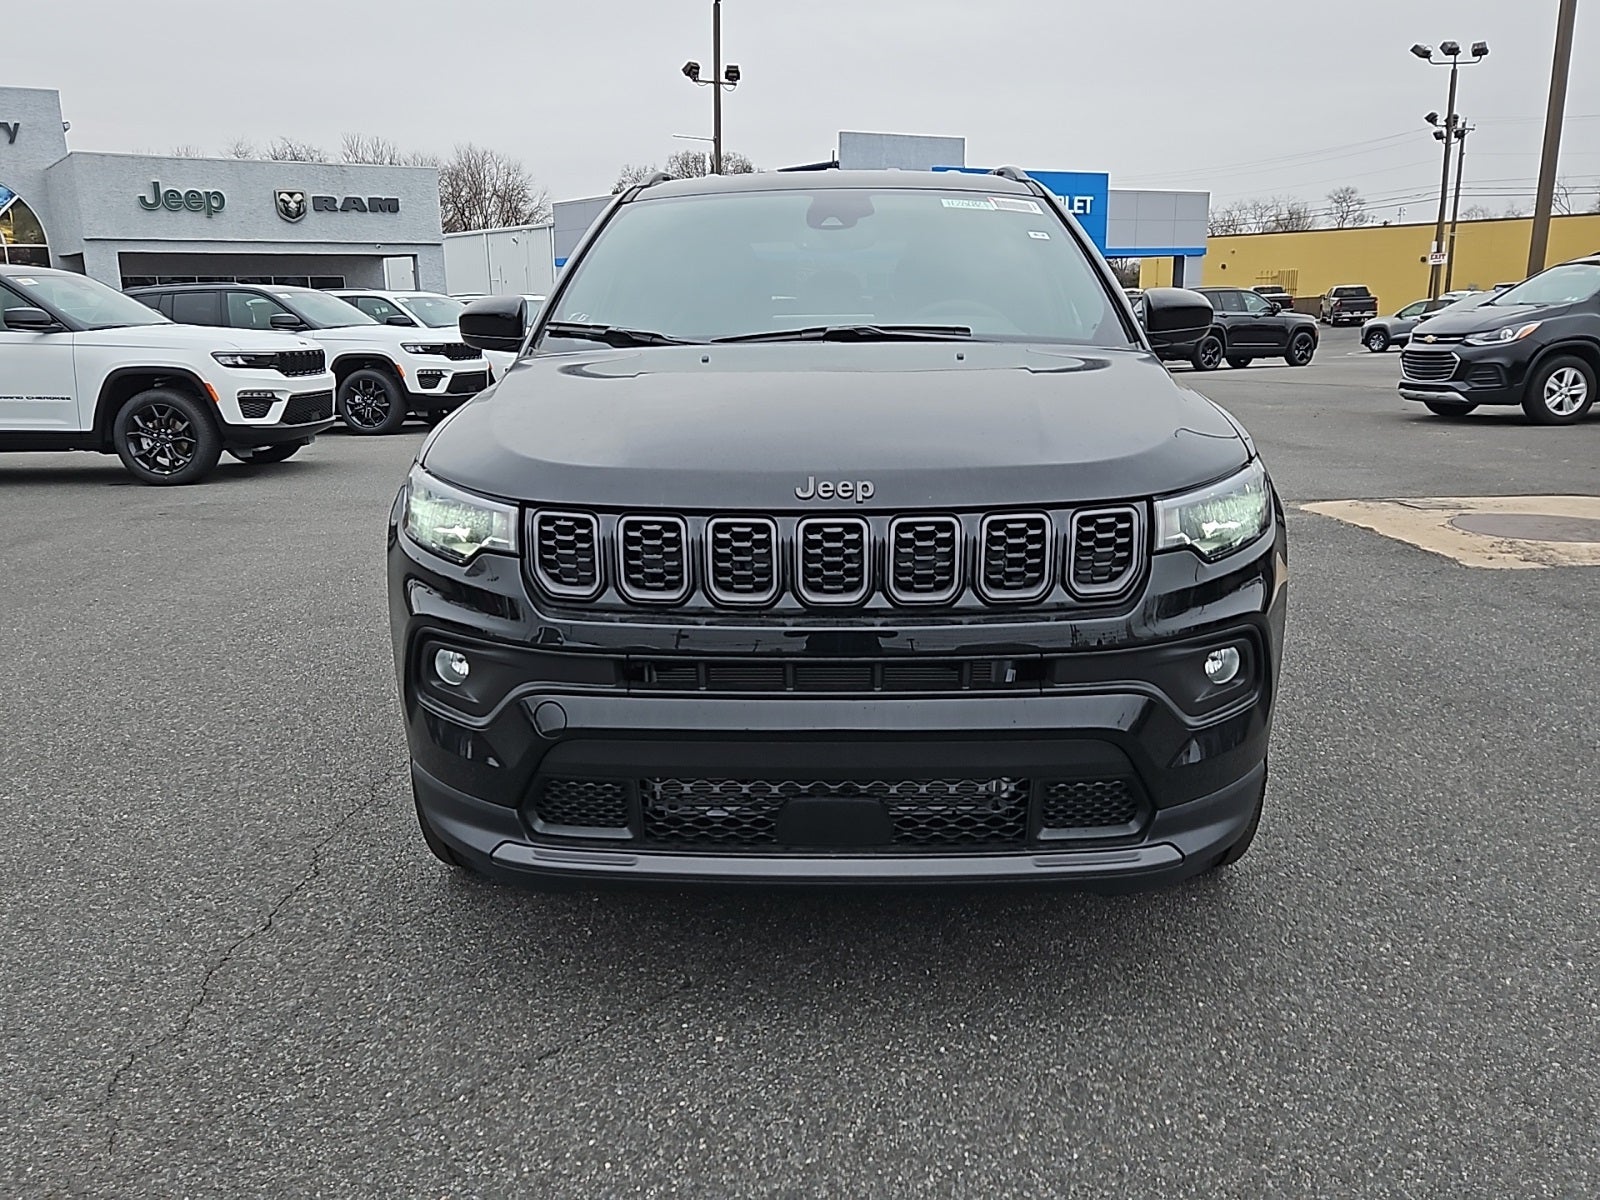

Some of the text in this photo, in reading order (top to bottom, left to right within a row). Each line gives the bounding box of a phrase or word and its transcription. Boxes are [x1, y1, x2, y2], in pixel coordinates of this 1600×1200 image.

[0, 121, 20, 144] y
[138, 180, 226, 218] Jeep
[311, 195, 400, 213] RAM
[794, 475, 875, 504] Jeep
